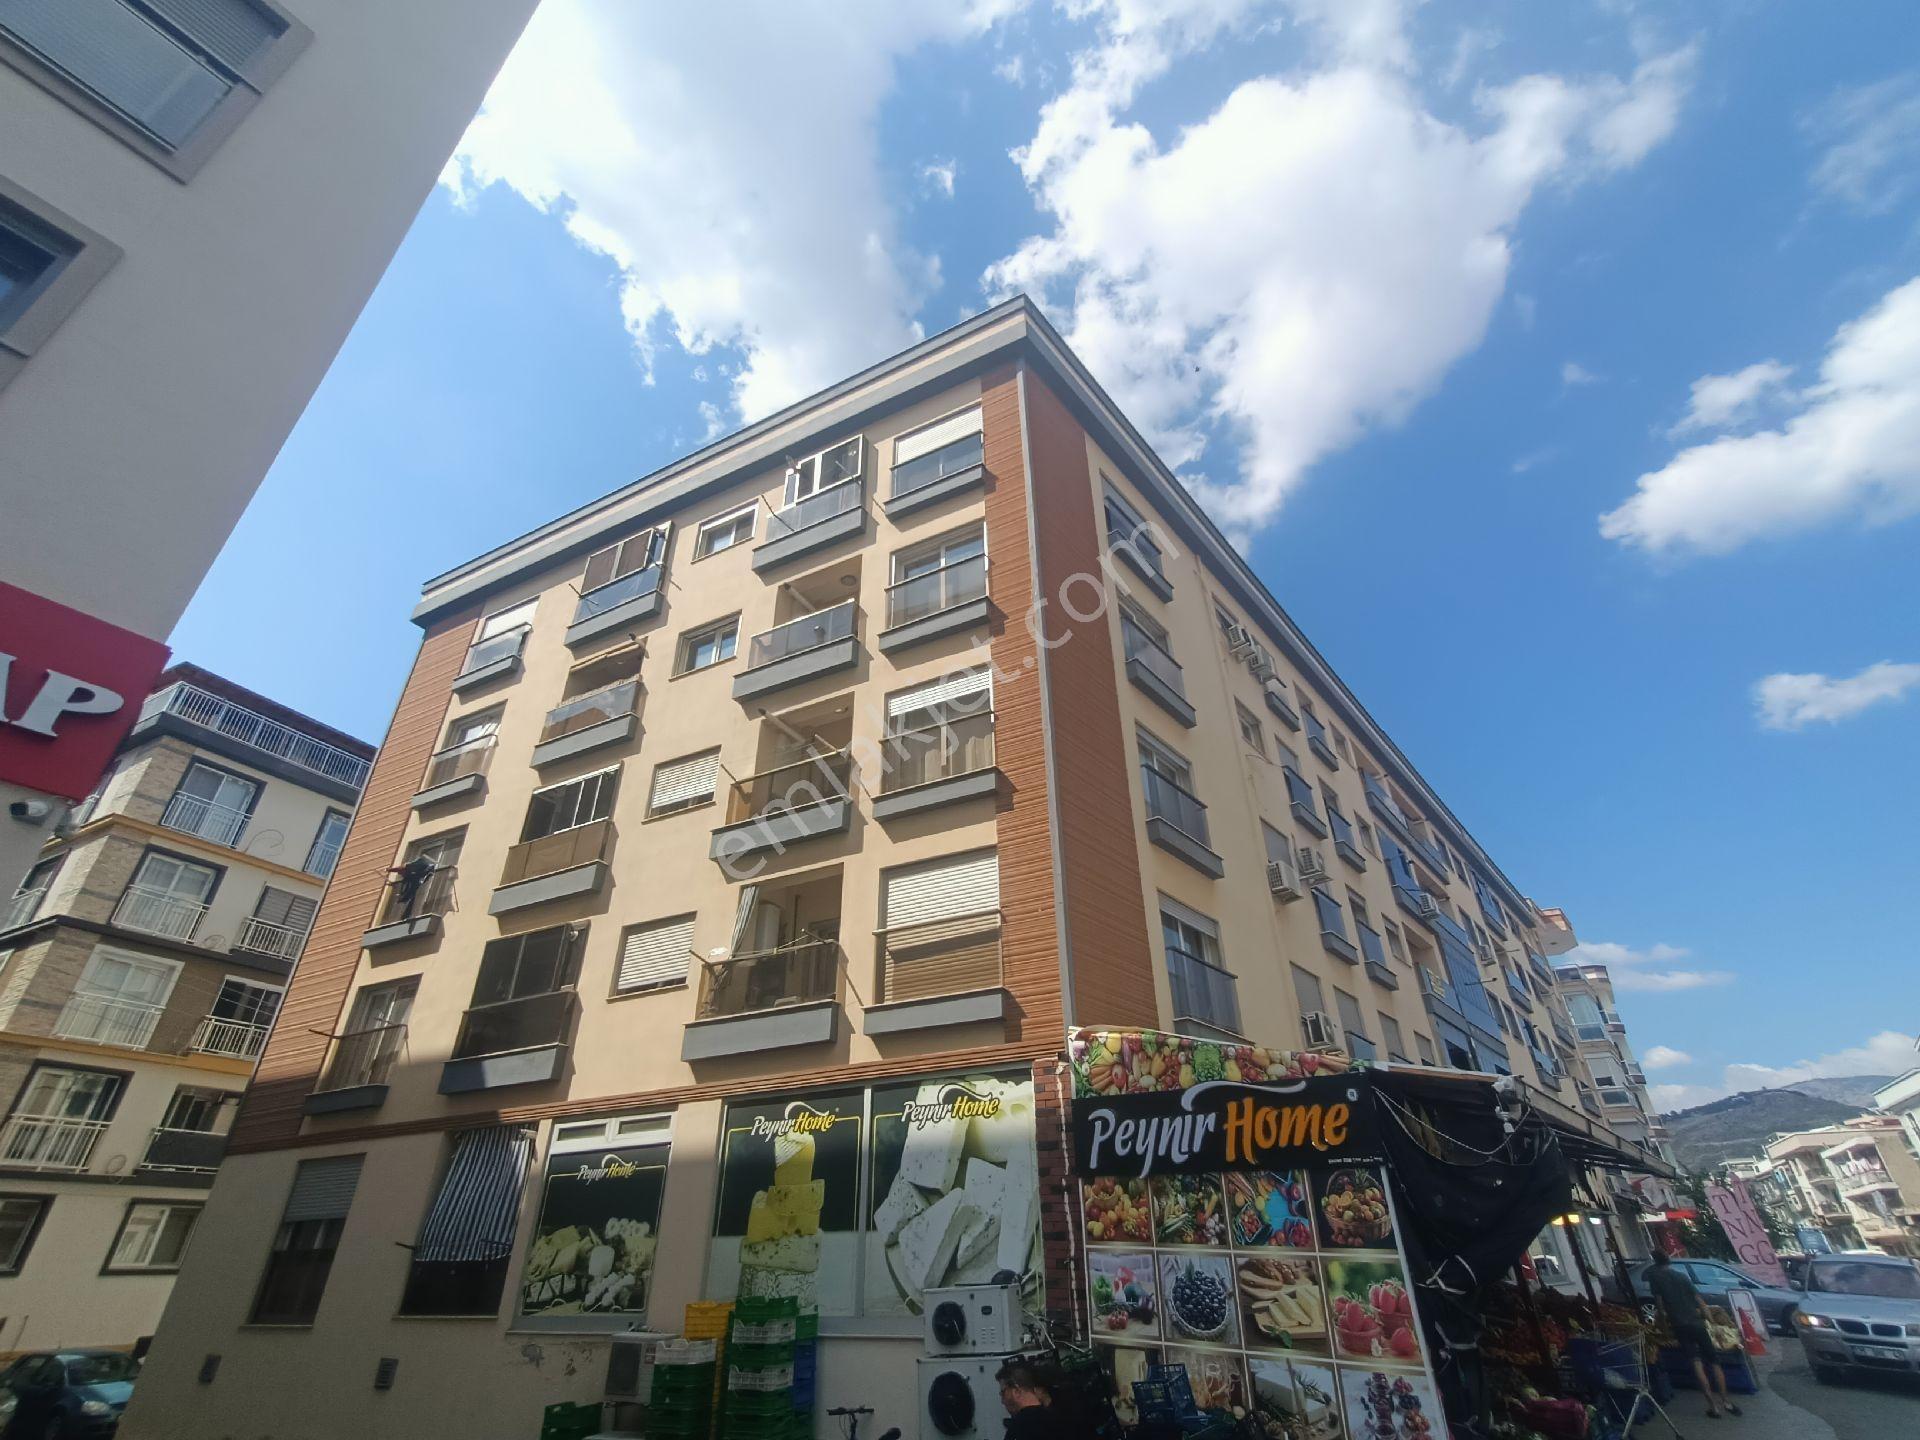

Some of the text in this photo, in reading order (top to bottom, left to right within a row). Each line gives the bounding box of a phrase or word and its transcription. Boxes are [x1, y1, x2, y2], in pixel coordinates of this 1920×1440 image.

[751, 1112, 836, 1142] Peynir Home
[902, 1096, 999, 1130] Peynir Home
[1088, 1097, 1349, 1178] Peynir Home
